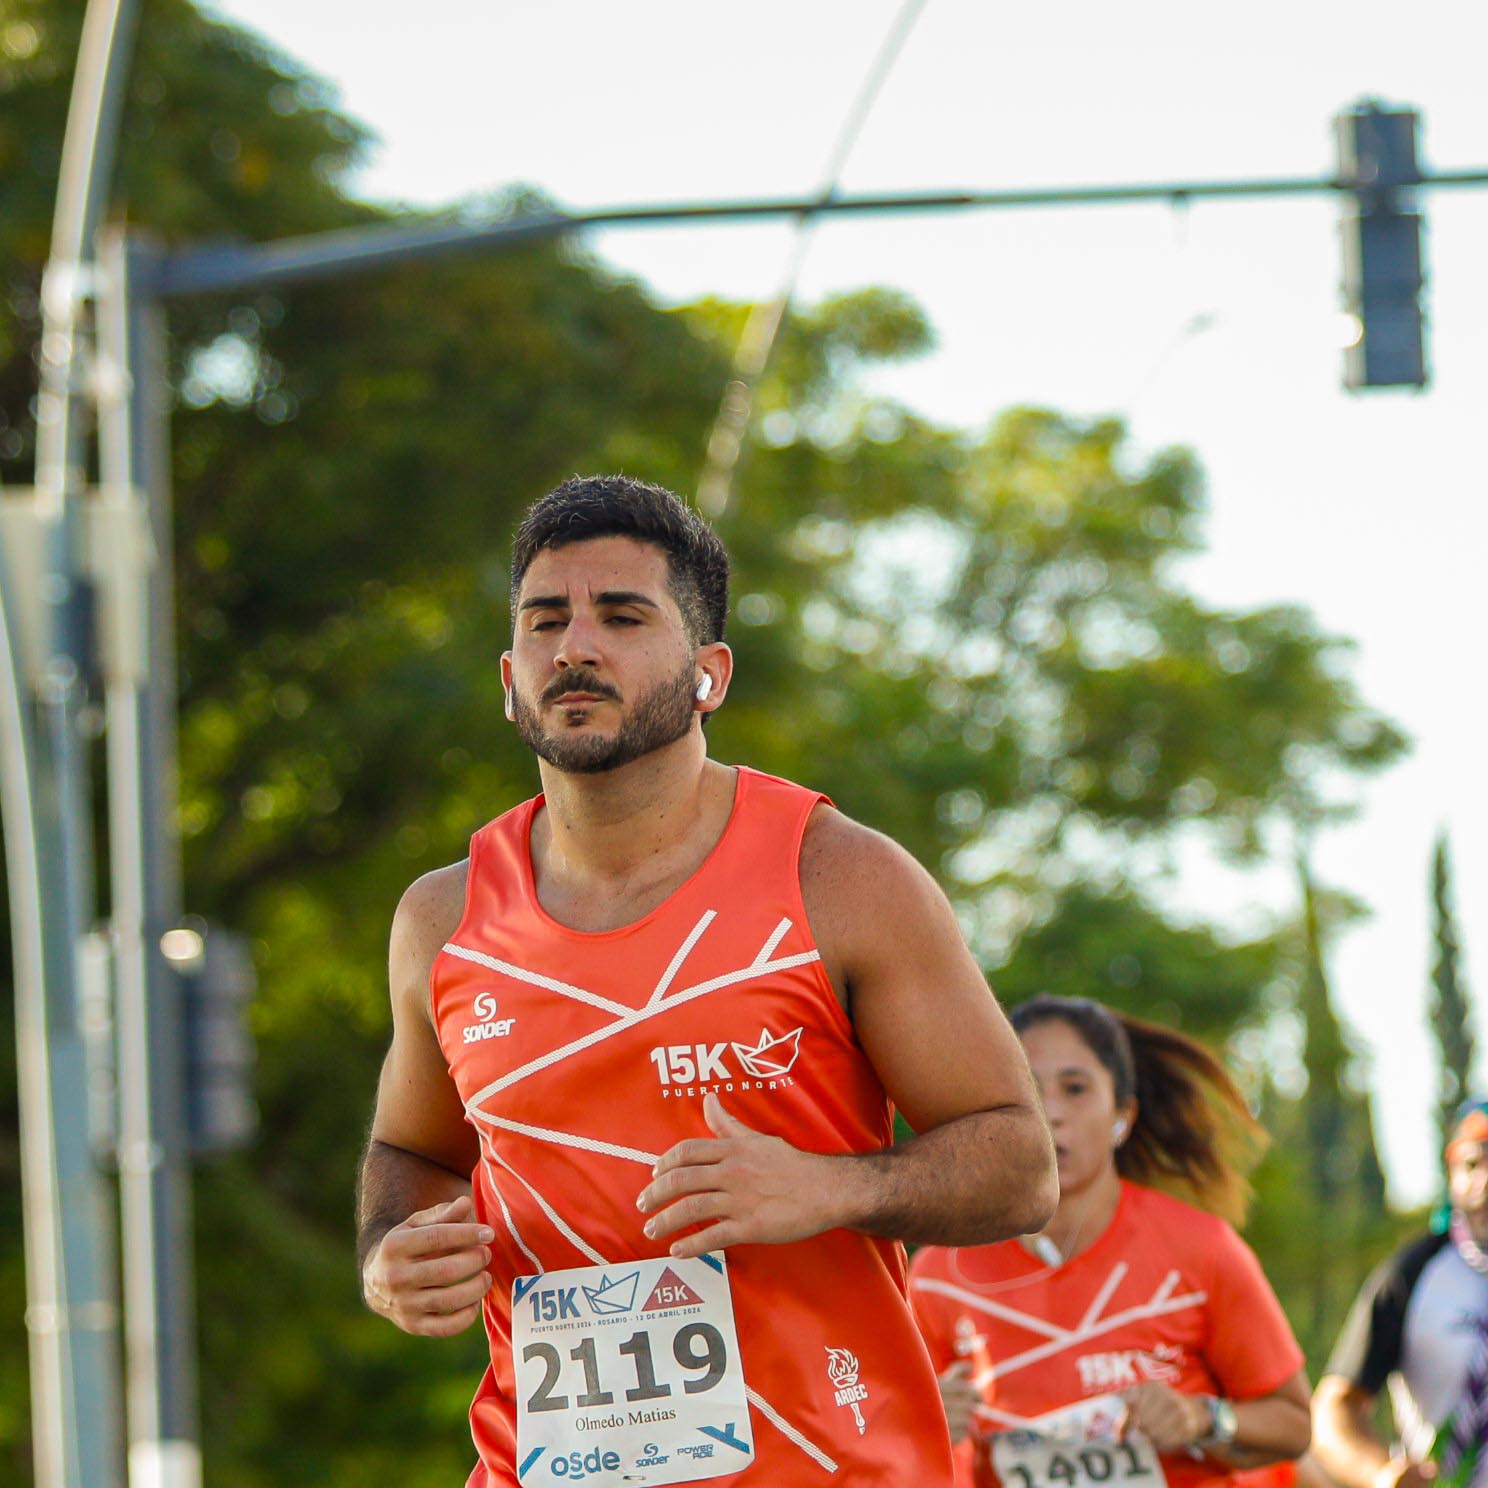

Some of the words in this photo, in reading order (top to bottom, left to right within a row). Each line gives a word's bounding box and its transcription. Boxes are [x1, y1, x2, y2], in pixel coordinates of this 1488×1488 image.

[650, 1042, 732, 1085] 15K
[662, 1083, 734, 1098] PUERTO
[741, 1077, 795, 1091] NORTE
[529, 1286, 581, 1323] 15K
[654, 1284, 689, 1304] 15K
[530, 1326, 554, 1334] PUERTO
[555, 1323, 574, 1331] NORTE
[597, 1317, 627, 1326] ROSARIO
[658, 1311, 680, 1319] ABRIL
[522, 1322, 727, 1413] 2119
[833, 1383, 869, 1407] ARDEC
[575, 1414, 624, 1432] Olmedo
[628, 1408, 677, 1426] Matias
[677, 1443, 714, 1456] POWER
[550, 1446, 621, 1478] osde
